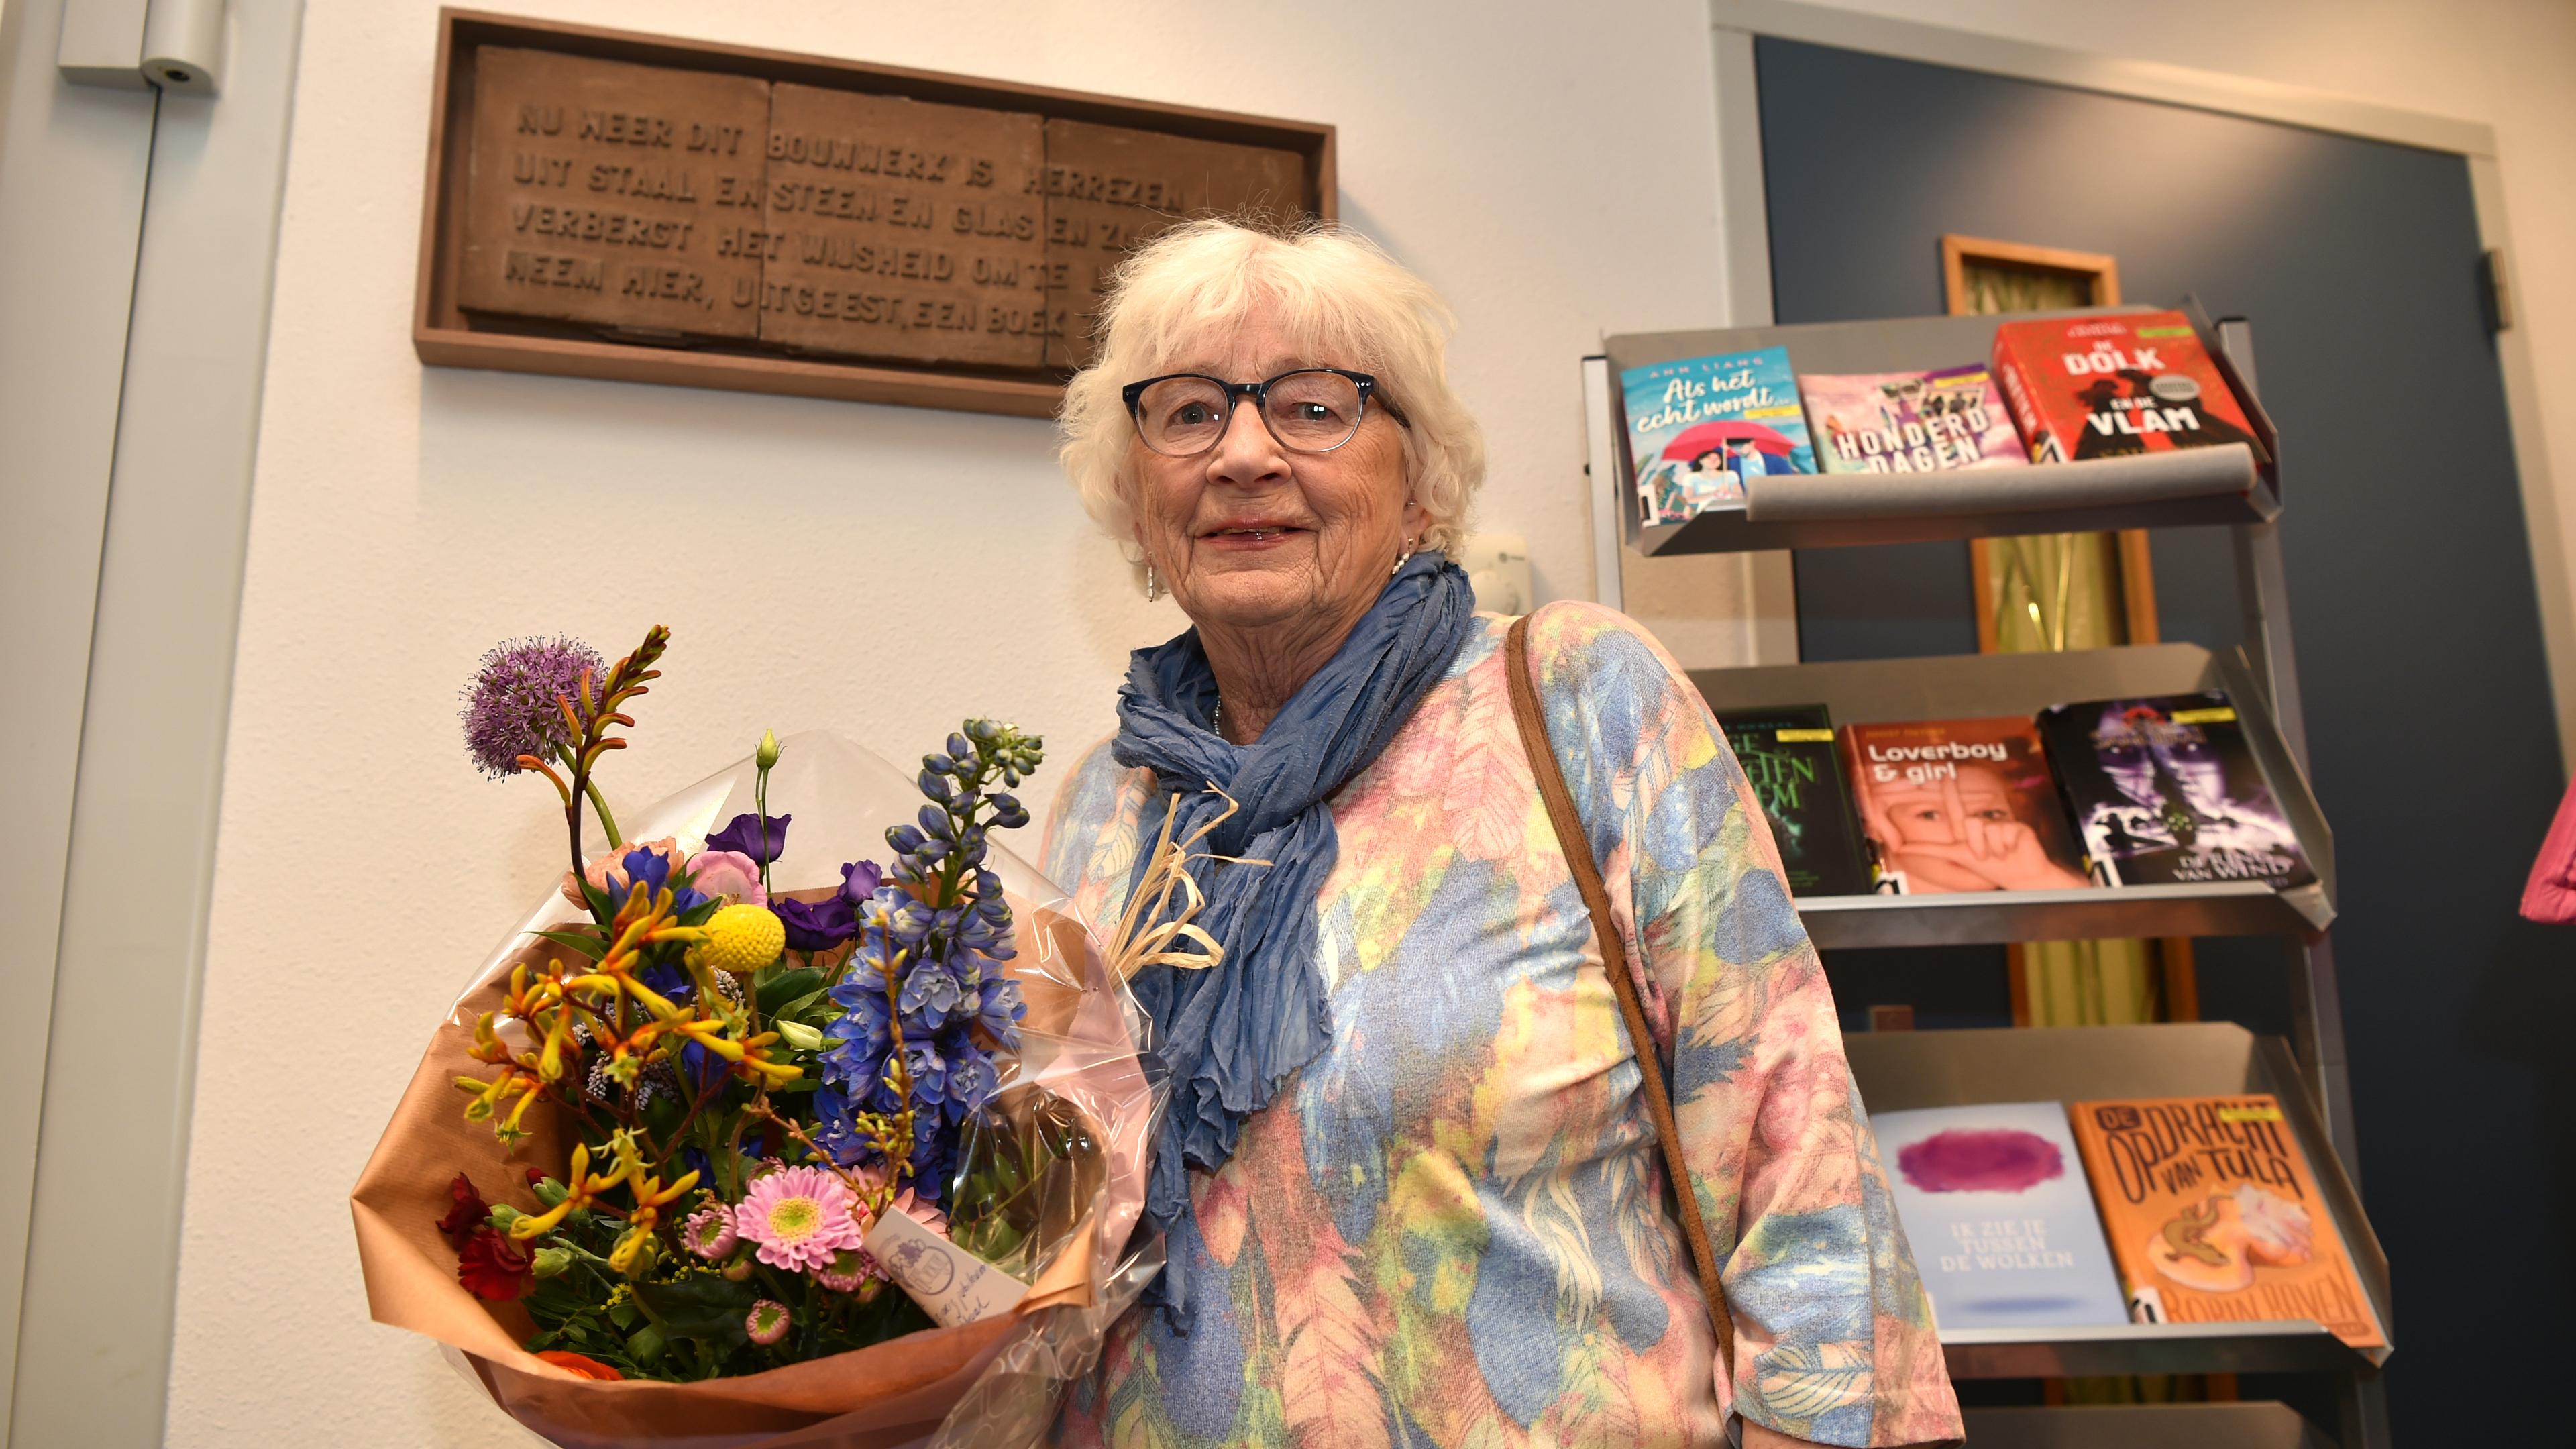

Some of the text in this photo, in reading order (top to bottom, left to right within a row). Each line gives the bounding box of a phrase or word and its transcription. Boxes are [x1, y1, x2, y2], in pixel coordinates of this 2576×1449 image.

[517, 105, 564, 136] NU
[686, 123, 743, 156] DIT
[965, 157, 994, 188] IS
[1024, 168, 1185, 213] HERREZEN
[513, 153, 572, 188] UIT
[588, 164, 697, 203] STAAL
[715, 175, 761, 211] EN
[773, 182, 879, 222] STEEN
[888, 197, 933, 231] EN
[953, 205, 1034, 242] GLAS
[1049, 216, 1090, 248] EN
[513, 204, 694, 252] VERBERGT
[718, 228, 785, 261] HET
[973, 257, 1018, 289] OM
[1027, 263, 1069, 291] TE
[505, 250, 602, 292] NEEM
[987, 305, 1067, 338] BOEK
[1650, 357, 1764, 378] ANN LIANG
[2061, 347, 2166, 376] DOLK
[1663, 368, 1756, 403] Als het
[1637, 398, 1702, 433] echt
[2086, 405, 2201, 436] VLAM
[1837, 407, 1990, 460] HONDERD
[1867, 436, 1980, 474] DAGEN
[1868, 740, 2008, 762] Loverboy
[1873, 761, 1958, 785] & girl
[2100, 1108, 2137, 1129] DE
[2162, 1148, 2304, 1200] VAN TULA
[1950, 1219, 2047, 1239] IK ZIE JE
[1961, 1234, 2046, 1255] TUSSEN
[1940, 1250, 2075, 1273] DE WOLKEN
